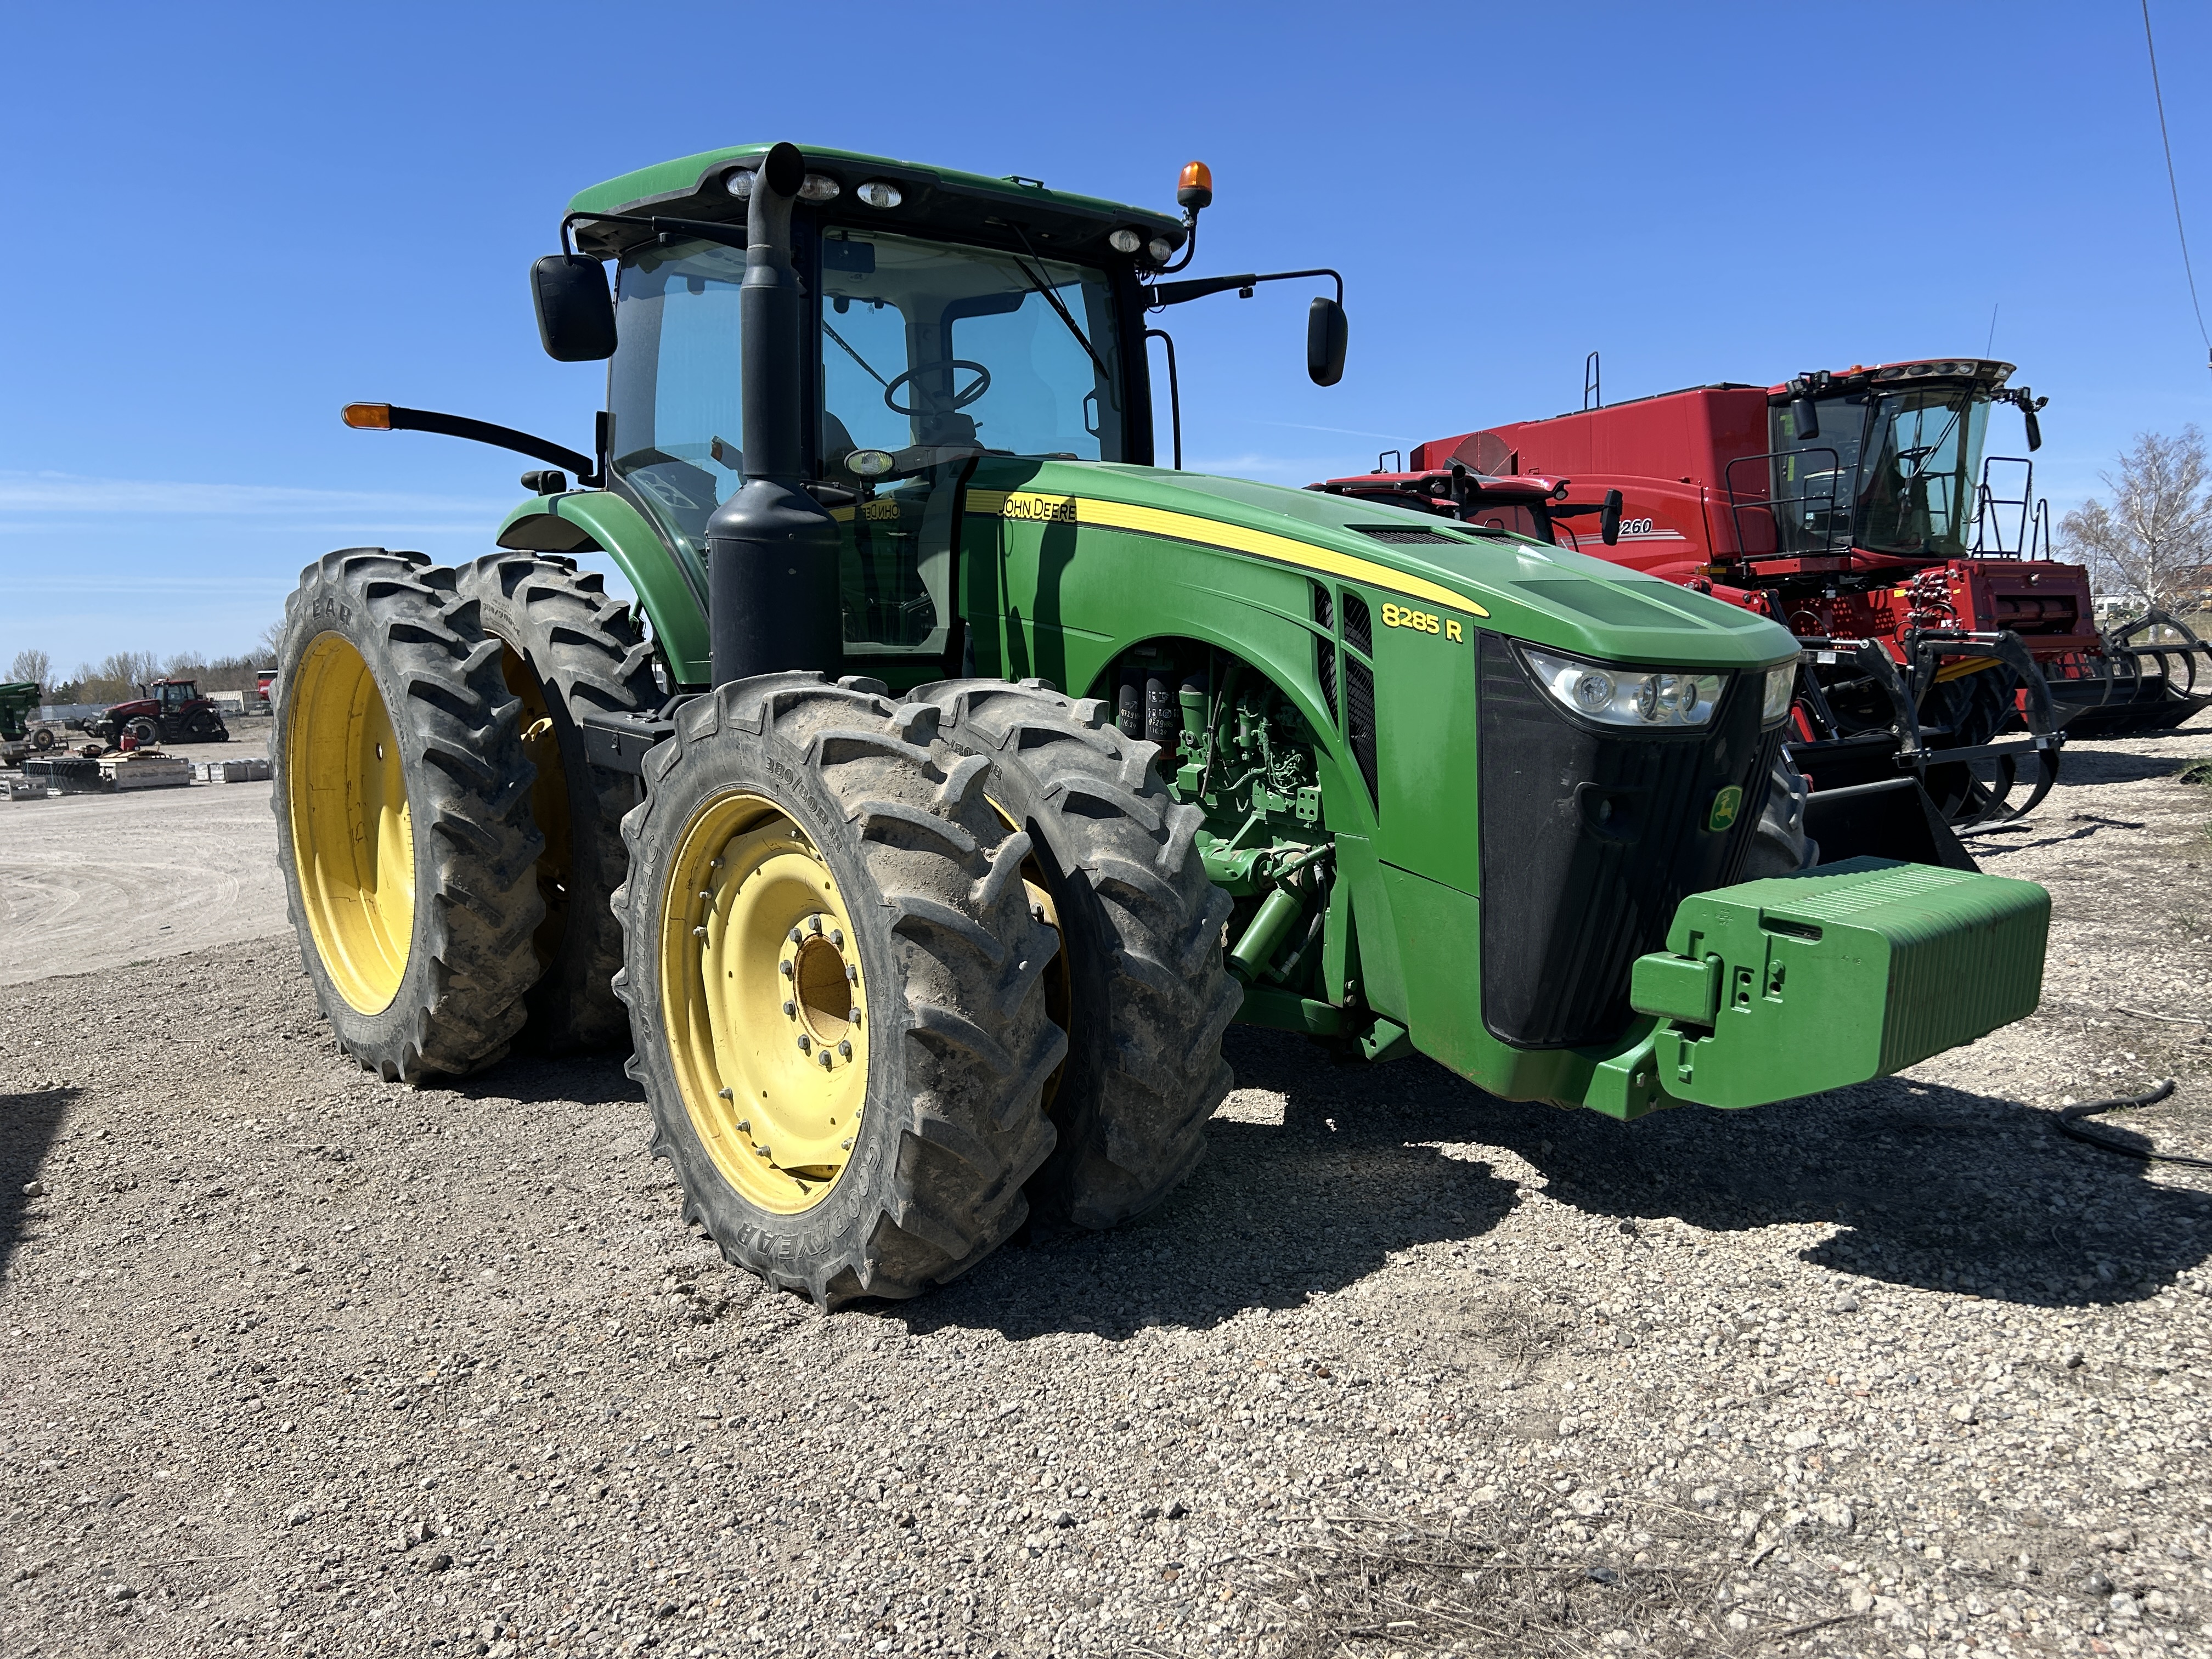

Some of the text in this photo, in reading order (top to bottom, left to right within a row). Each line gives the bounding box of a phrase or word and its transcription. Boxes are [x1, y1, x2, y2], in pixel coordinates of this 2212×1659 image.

[998, 495, 1076, 520] JOHN DEERE
[1619, 518, 1653, 535] 260
[1381, 602, 1464, 645] 8285 R
[1121, 708, 1134, 720] 9729
[1149, 718, 1164, 728] 9729
[765, 755, 843, 853] 380/80R38
[736, 1137, 882, 1260] GOODYEAR
